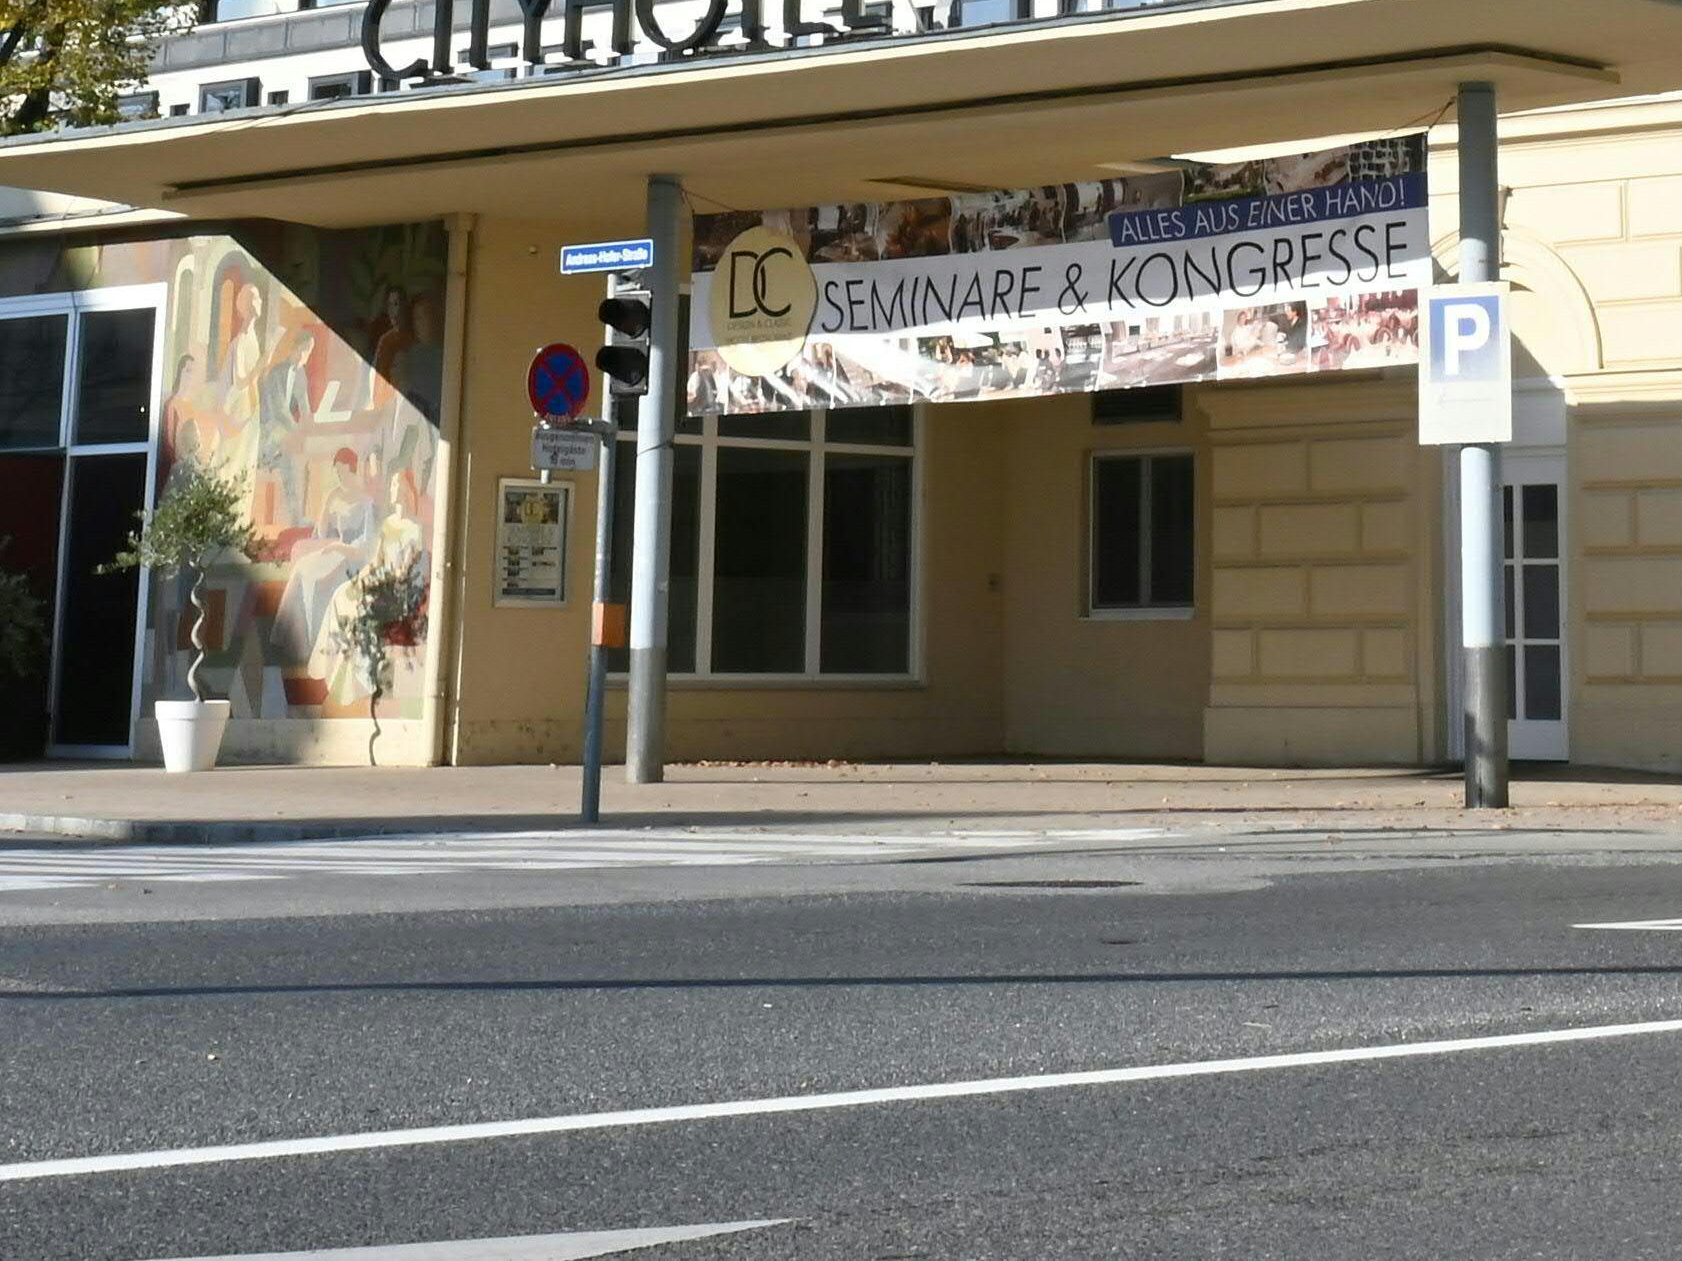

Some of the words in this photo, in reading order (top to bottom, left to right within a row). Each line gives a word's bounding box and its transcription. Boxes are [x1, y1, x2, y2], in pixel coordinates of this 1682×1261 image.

[1120, 211, 1187, 244] ALLES
[1193, 203, 1240, 236] AUS
[1247, 189, 1318, 229] EINER
[1325, 180, 1407, 218] HAND!
[729, 247, 792, 320] DC
[821, 265, 1042, 334] SEMINARE
[1057, 262, 1089, 316] &
[1108, 220, 1408, 311] KONGRESSE
[1444, 303, 1491, 376] P
